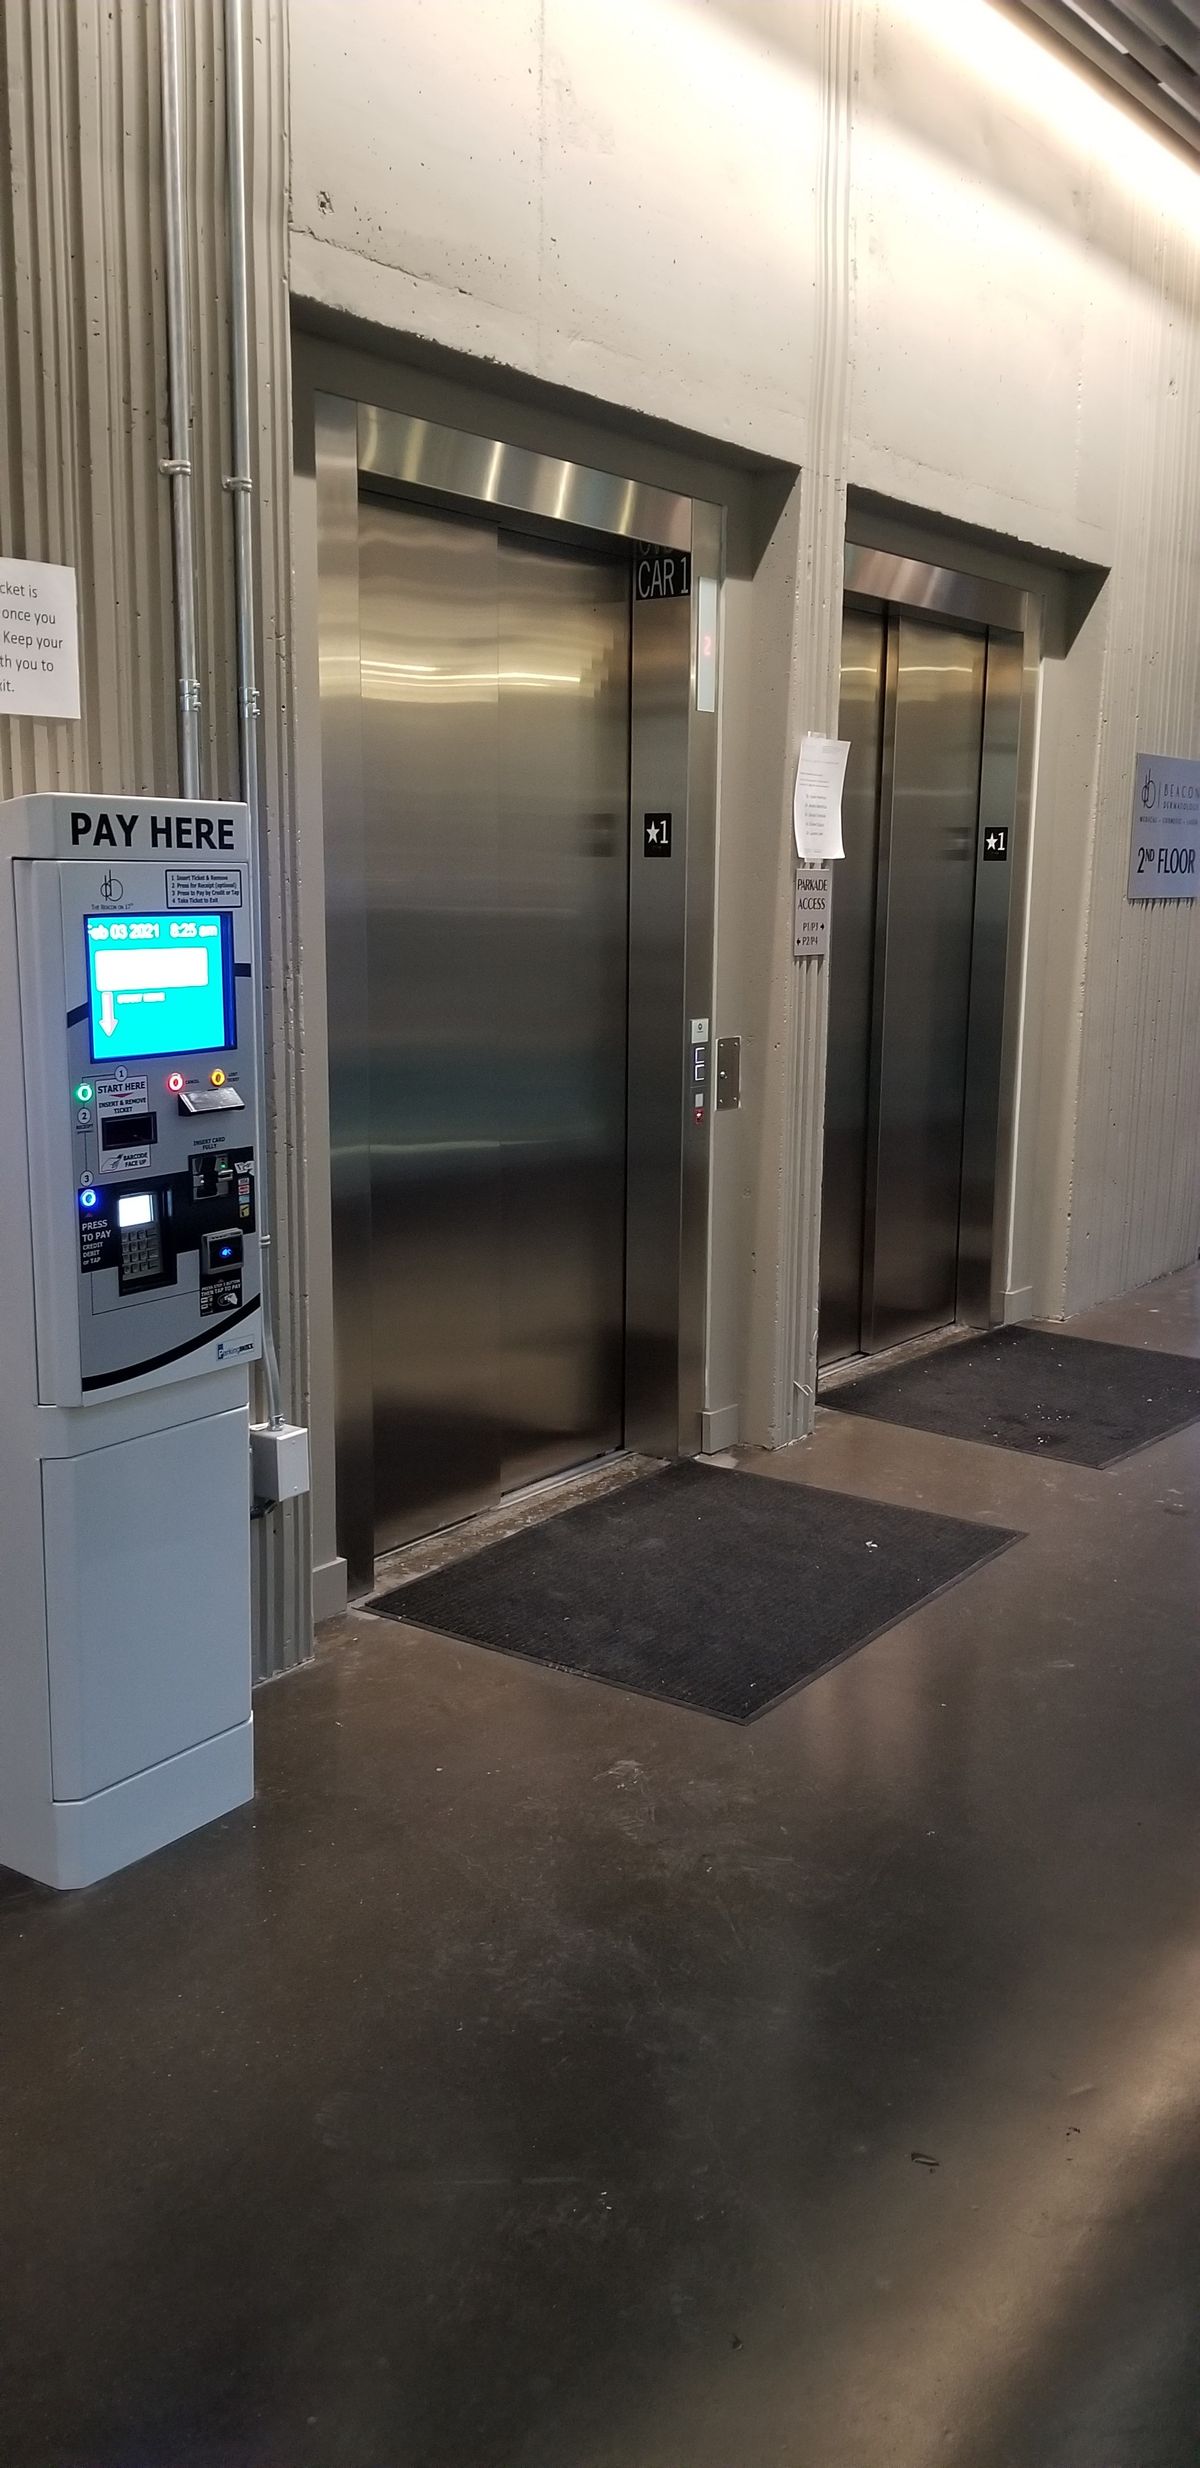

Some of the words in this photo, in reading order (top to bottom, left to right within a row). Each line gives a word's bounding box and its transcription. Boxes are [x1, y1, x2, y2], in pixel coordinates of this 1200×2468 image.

[638, 559, 674, 598] CAR
[681, 557, 689, 594] 1
[29, 585, 38, 598] is
[2, 608, 30, 621] once
[34, 612, 56, 626] you
[3, 630, 33, 648] Keep
[36, 637, 63, 650] your
[16, 659, 38, 672] you
[42, 660, 54, 672] to
[71, 812, 139, 847] PAY
[151, 816, 235, 850] HERE
[1157, 848, 1196, 874] FLOOR
[797, 879, 828, 891] PARKADE
[798, 898, 826, 910] ACCESS
[129, 923, 160, 940] 2021
[98, 1084, 123, 1094] START
[125, 1081, 146, 1091] HERE
[125, 1097, 146, 1105] REMOVE
[123, 1152, 148, 1161] BARCODE
[82, 1219, 108, 1231] PRESS
[82, 1233, 94, 1242] TO
[95, 1230, 111, 1240] PAY
[82, 1242, 104, 1250] CREDIT
[83, 1250, 100, 1258] DEBIT
